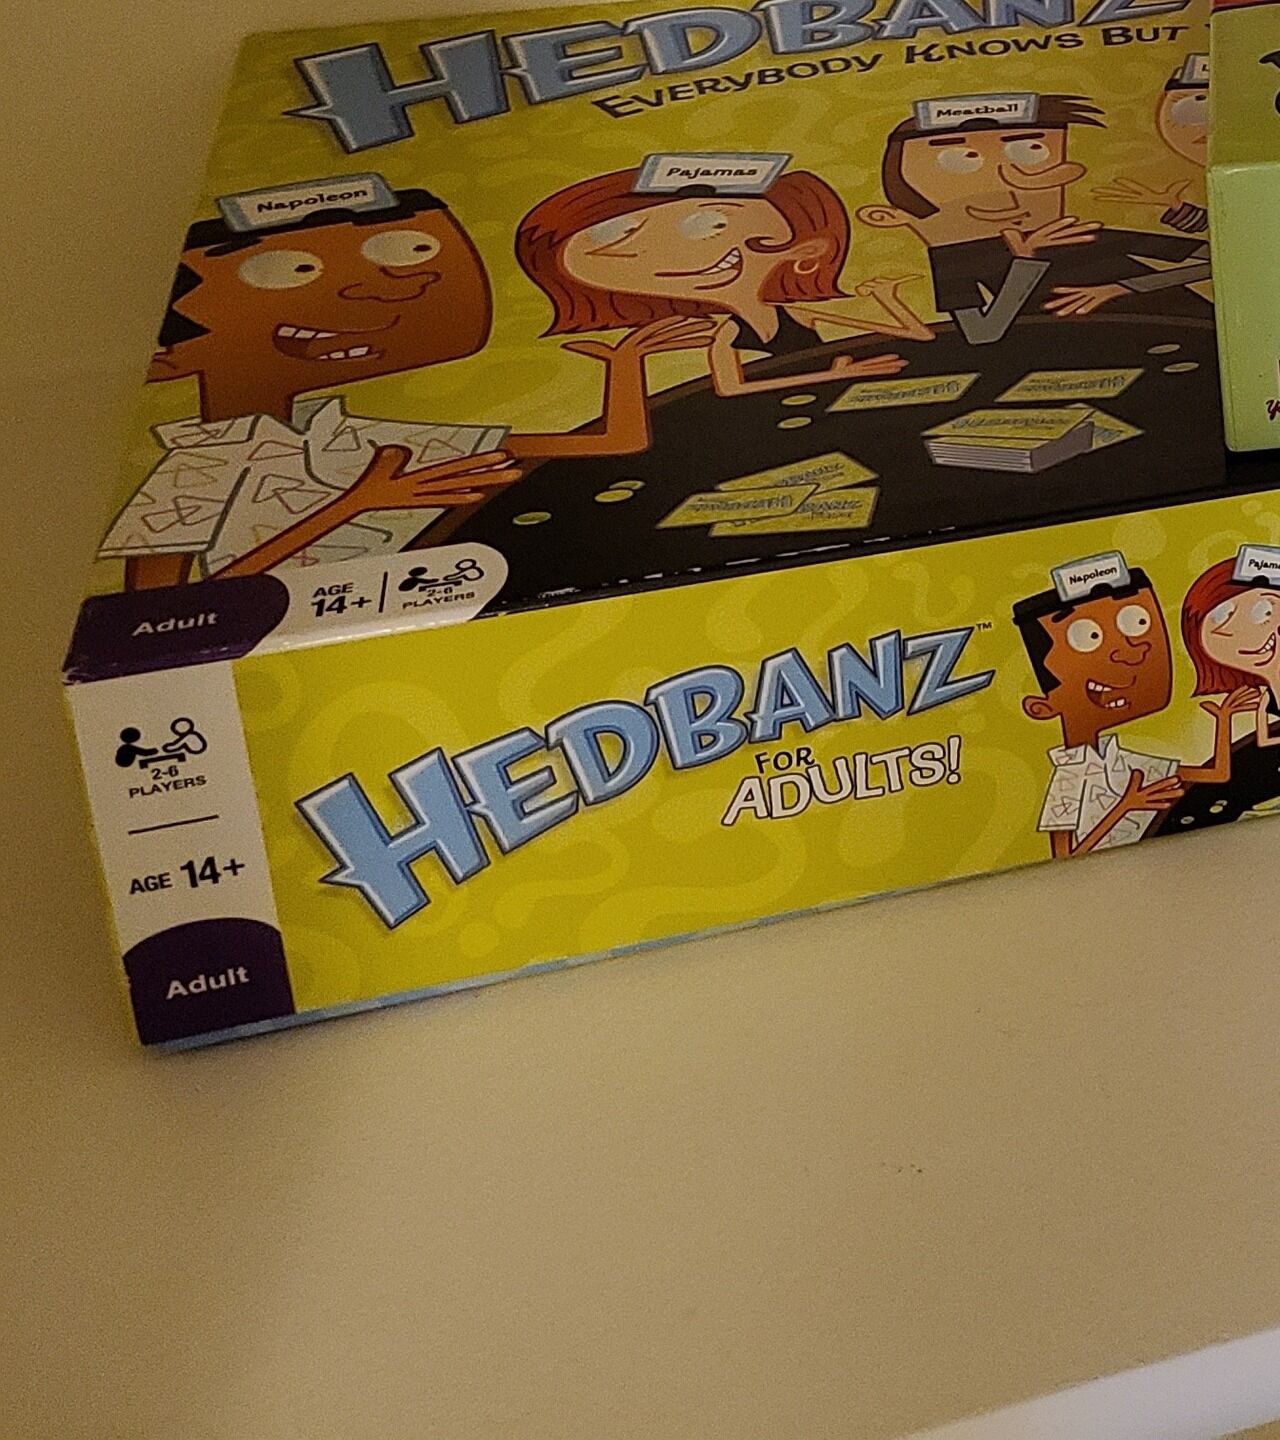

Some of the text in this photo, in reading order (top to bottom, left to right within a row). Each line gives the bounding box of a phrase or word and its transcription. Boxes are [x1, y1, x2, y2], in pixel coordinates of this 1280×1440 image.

[591, 25, 1191, 119] EVERYBODY KNOWS BUT
[935, 102, 1020, 121] Meatball
[664, 161, 759, 181] Pajamas
[256, 184, 369, 219] Napoleon
[1068, 564, 1118, 585] Napoleon
[311, 581, 355, 599] AGE
[401, 591, 476, 611] PLAYERS
[310, 593, 374, 618] 14+
[130, 610, 219, 638] Adult
[755, 745, 814, 775] FOR
[127, 775, 207, 799] PLAYERS
[150, 766, 179, 782] 2-6
[294, 627, 996, 929] HEDBANZ
[721, 735, 963, 827] ADULTS!
[128, 856, 246, 895] AGE 14+
[165, 966, 250, 1000] Adult
